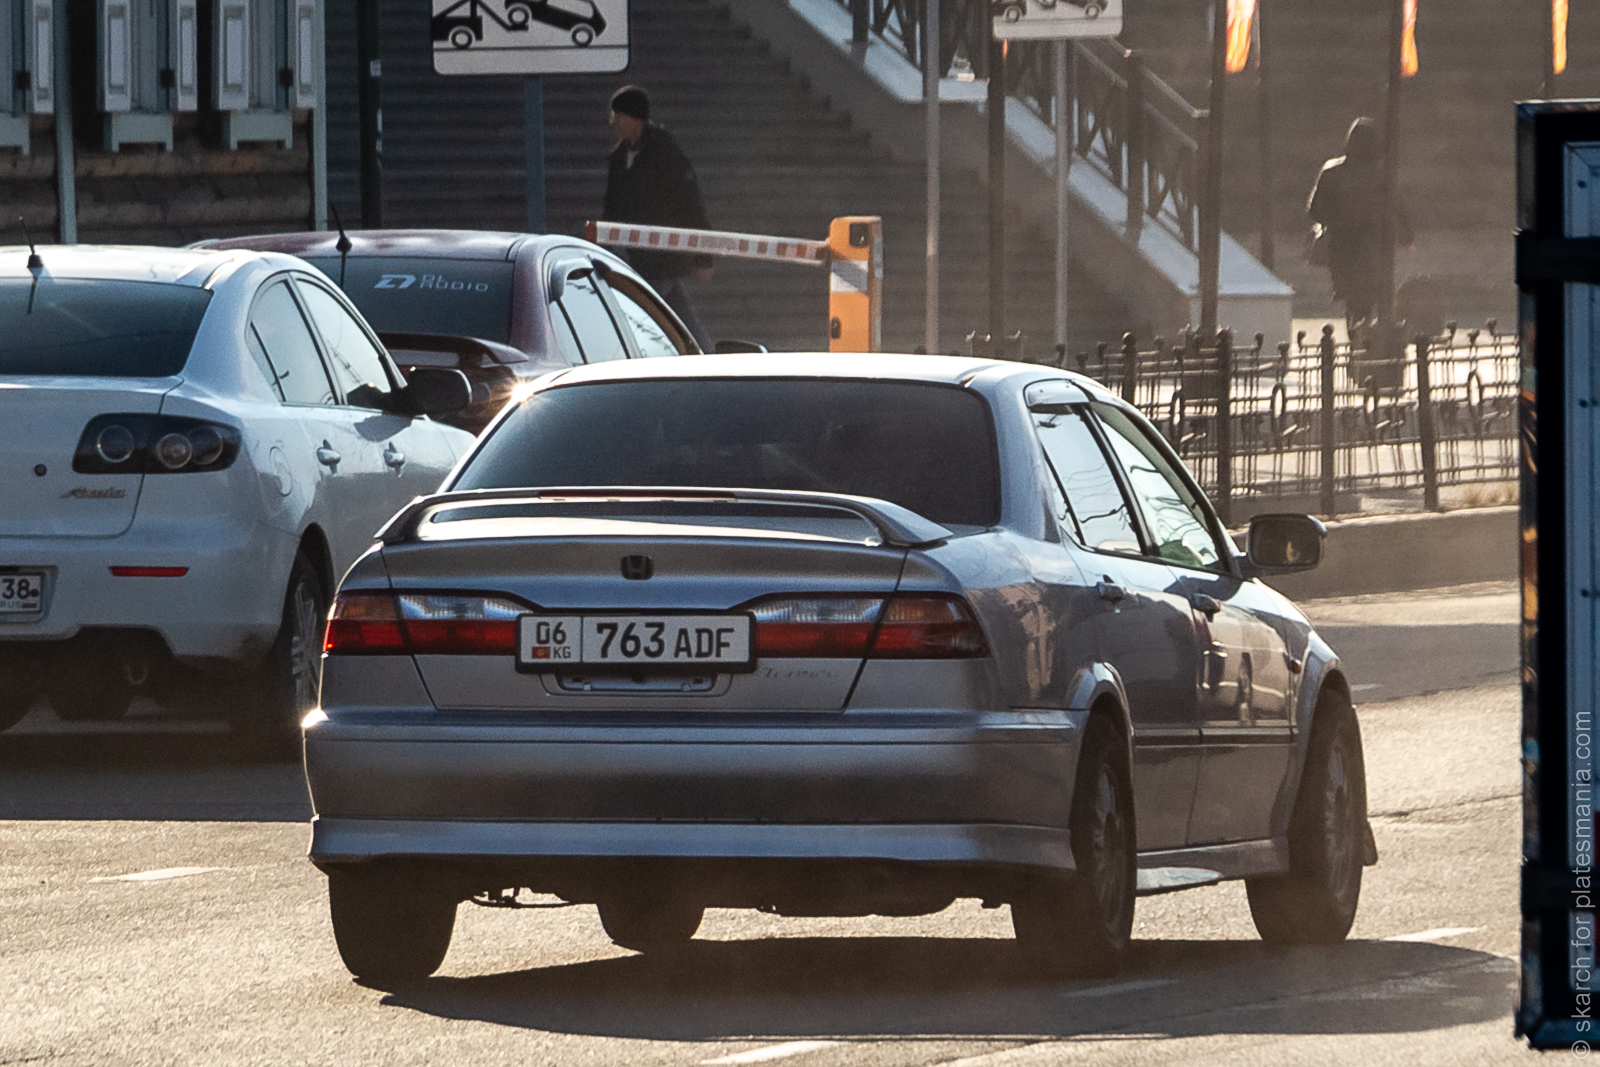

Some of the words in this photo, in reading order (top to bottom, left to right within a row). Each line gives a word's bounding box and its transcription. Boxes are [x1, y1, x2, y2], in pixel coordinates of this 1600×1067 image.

[536, 621, 567, 645] 06
[596, 622, 665, 658] 763
[673, 628, 735, 658] ADF
[553, 646, 572, 659] KG
